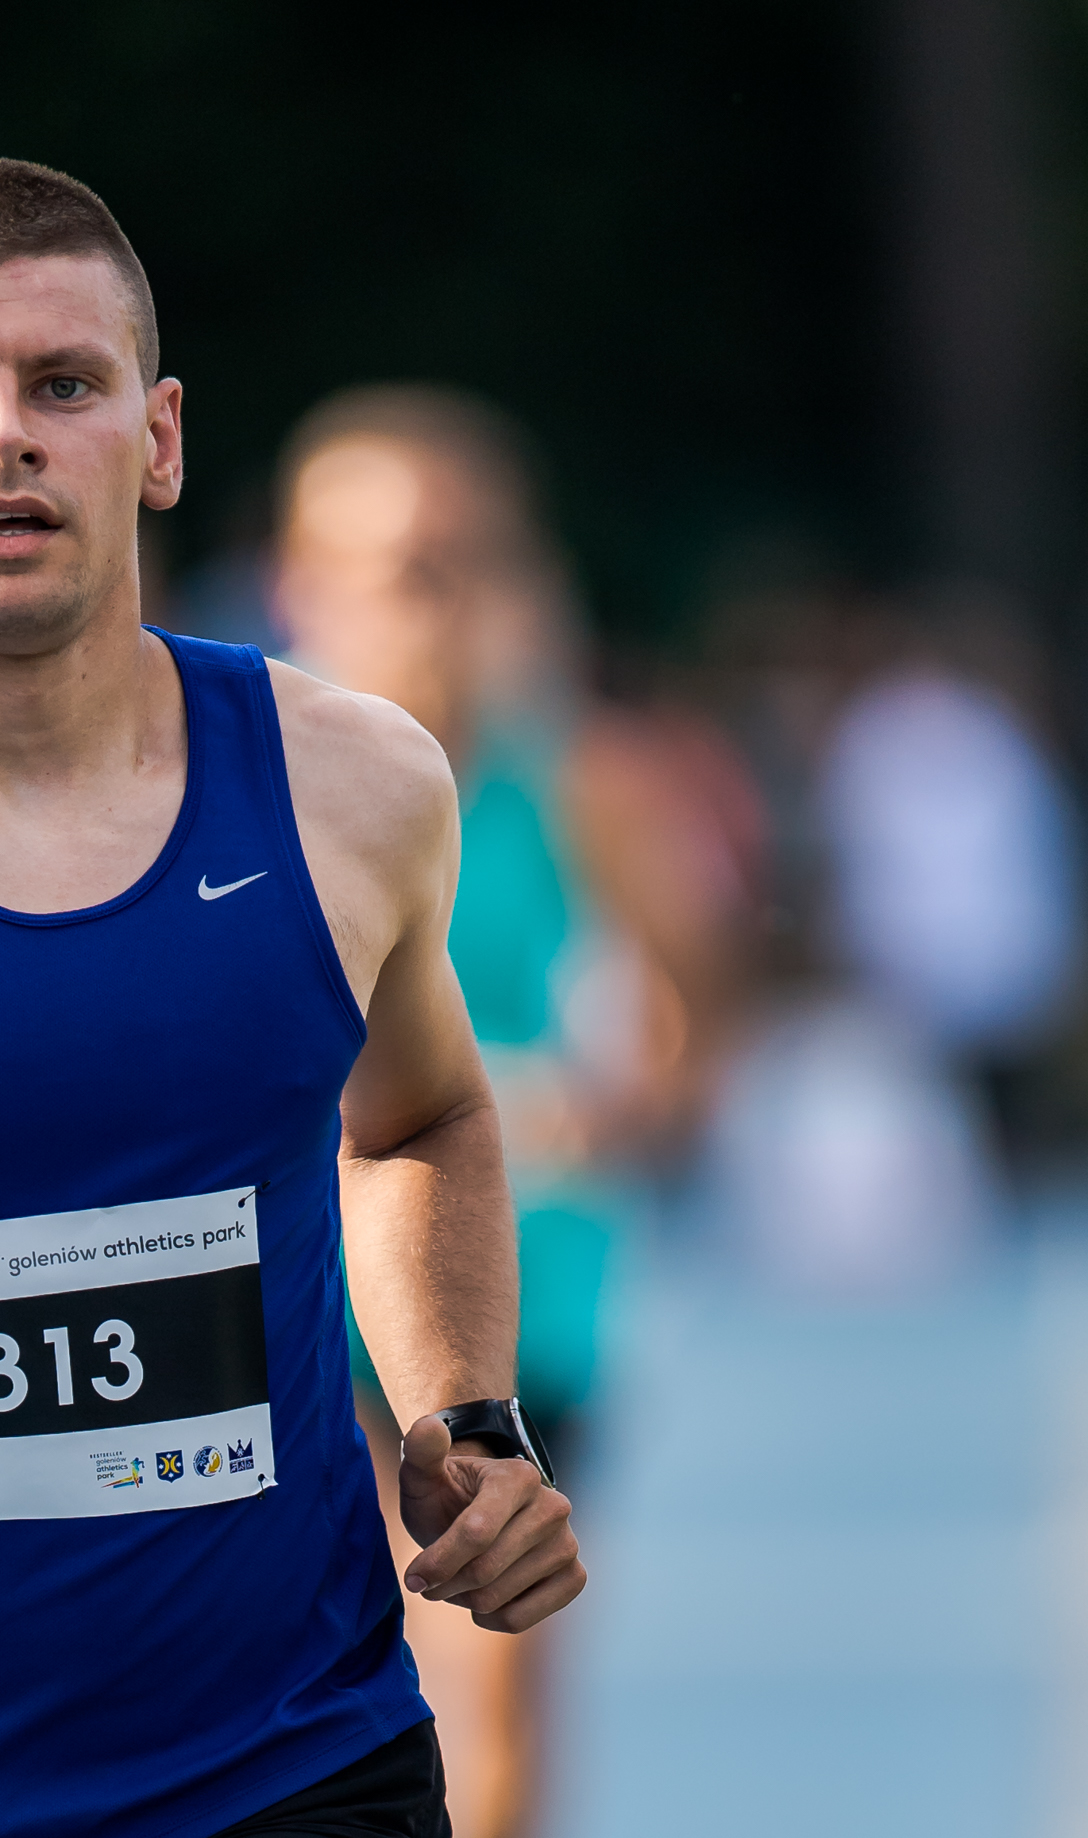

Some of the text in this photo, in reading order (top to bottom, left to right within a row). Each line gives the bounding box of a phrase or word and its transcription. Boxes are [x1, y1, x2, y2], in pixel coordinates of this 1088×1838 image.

[9, 1245, 97, 1277] goleniów
[103, 1232, 195, 1259] athletics
[202, 1221, 246, 1250] park
[97, 1472, 115, 1481] park
